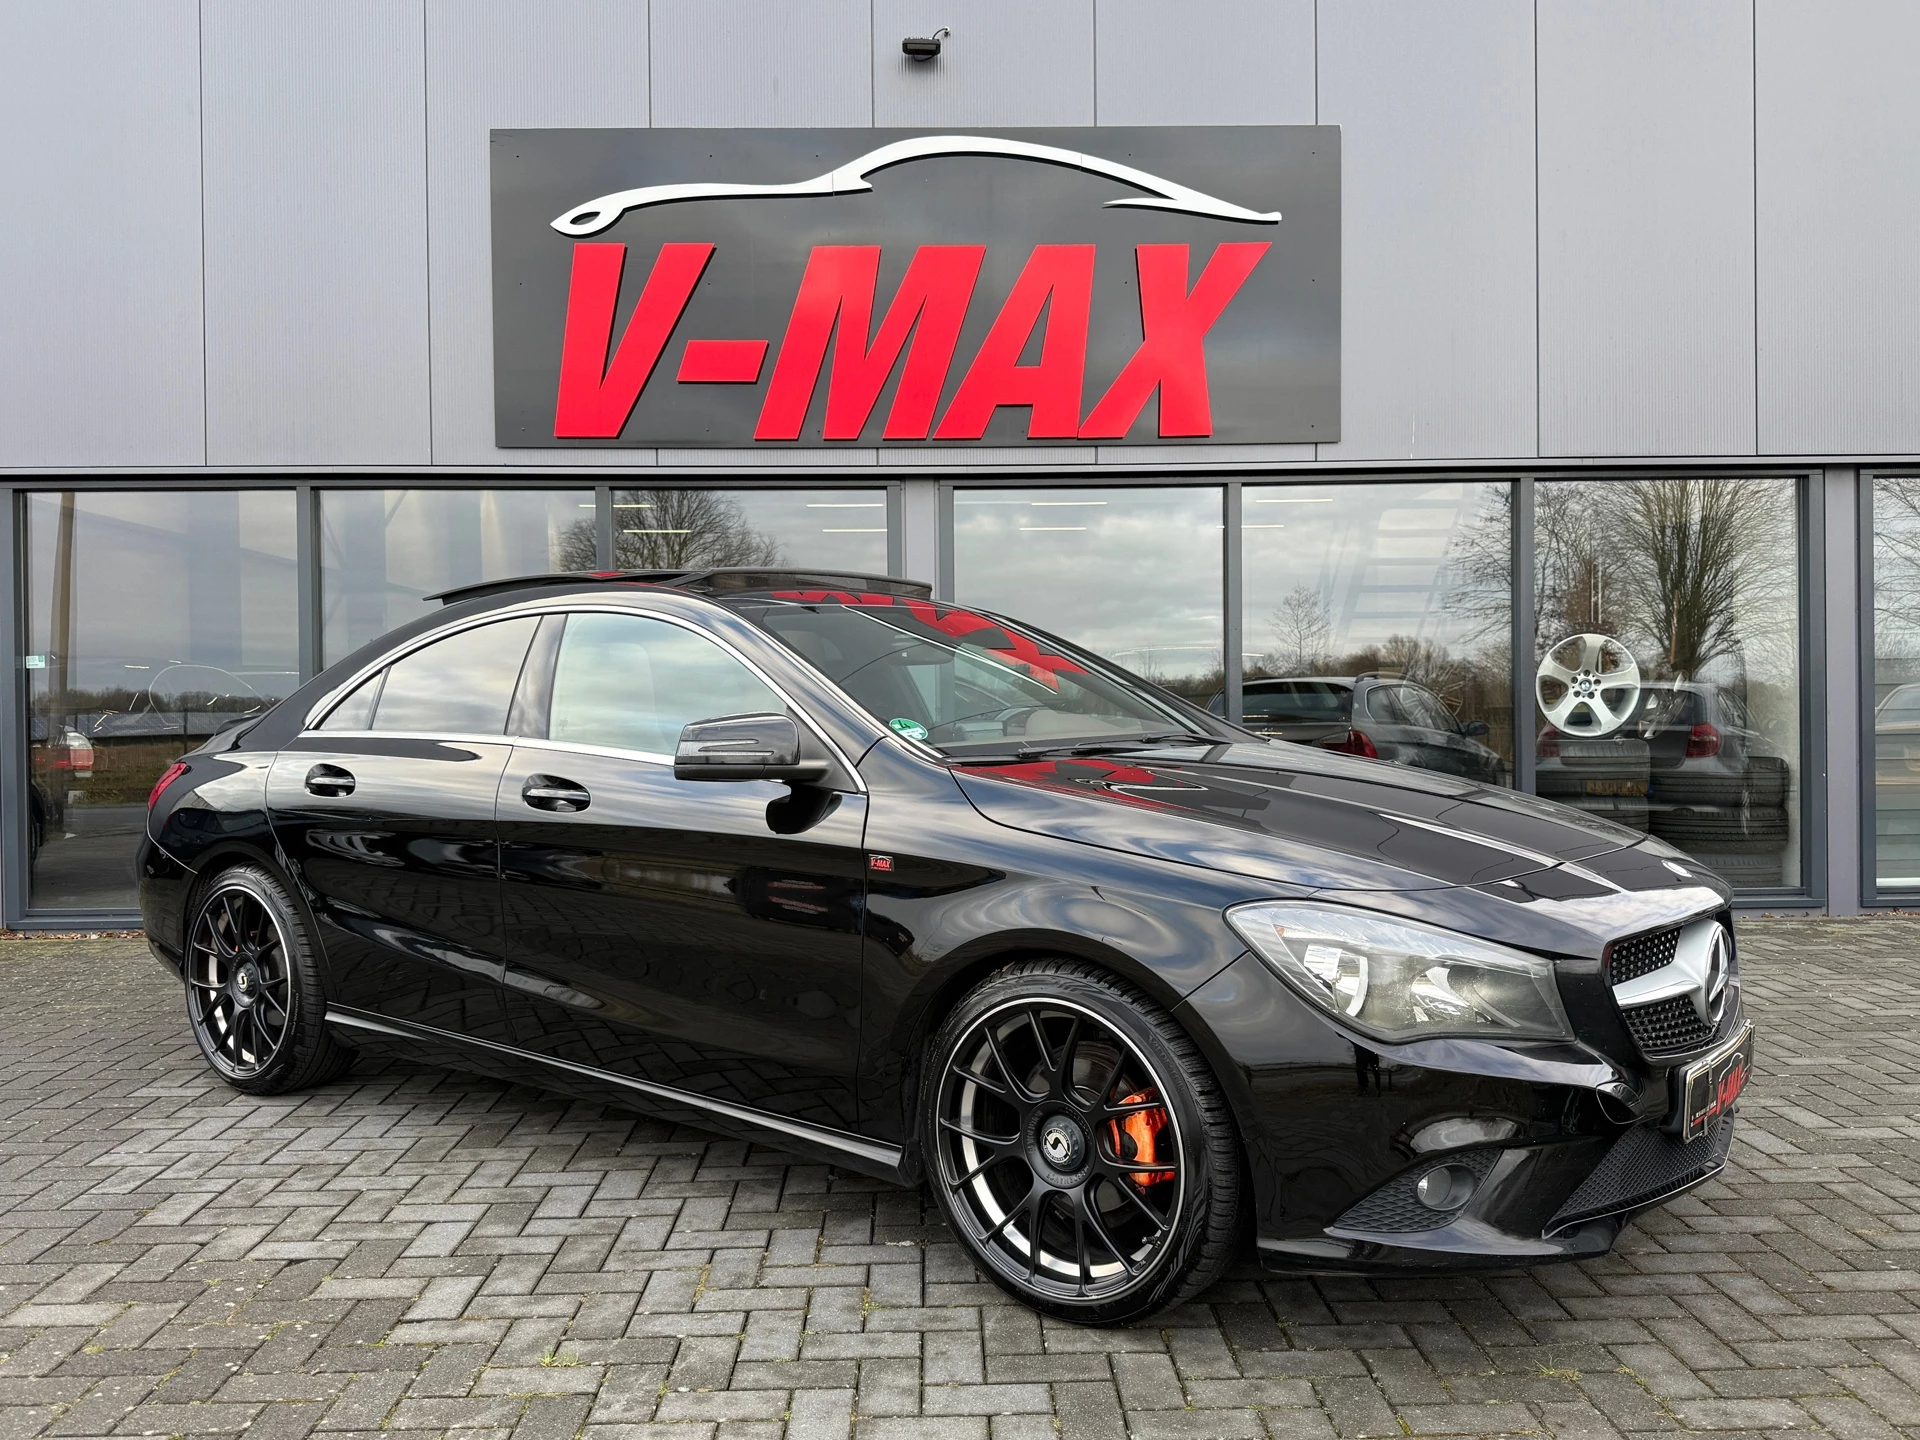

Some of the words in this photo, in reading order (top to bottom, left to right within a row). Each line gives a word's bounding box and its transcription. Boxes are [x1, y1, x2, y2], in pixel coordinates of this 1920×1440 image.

[554, 241, 1272, 441] V-MAX
[897, 719, 911, 729] 4
[870, 858, 891, 868] V-MAX
